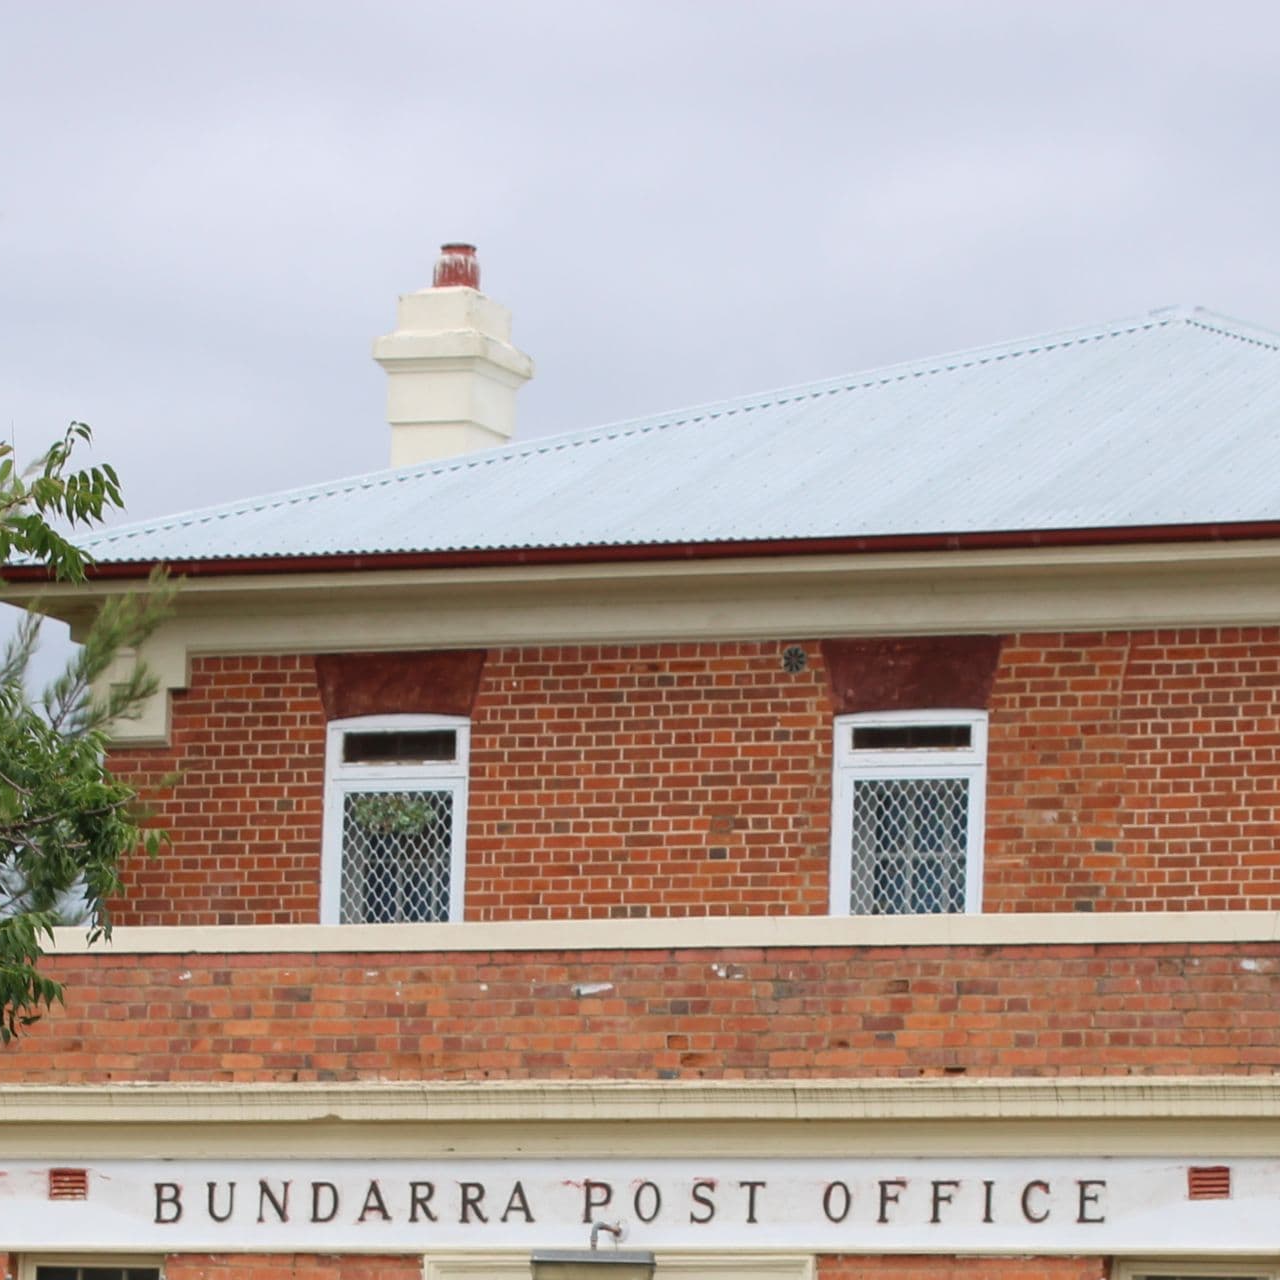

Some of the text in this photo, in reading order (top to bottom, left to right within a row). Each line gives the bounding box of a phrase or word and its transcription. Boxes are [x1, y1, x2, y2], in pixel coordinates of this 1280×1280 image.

[154, 1180, 1106, 1224] BUNDARRA POST OFFICE
